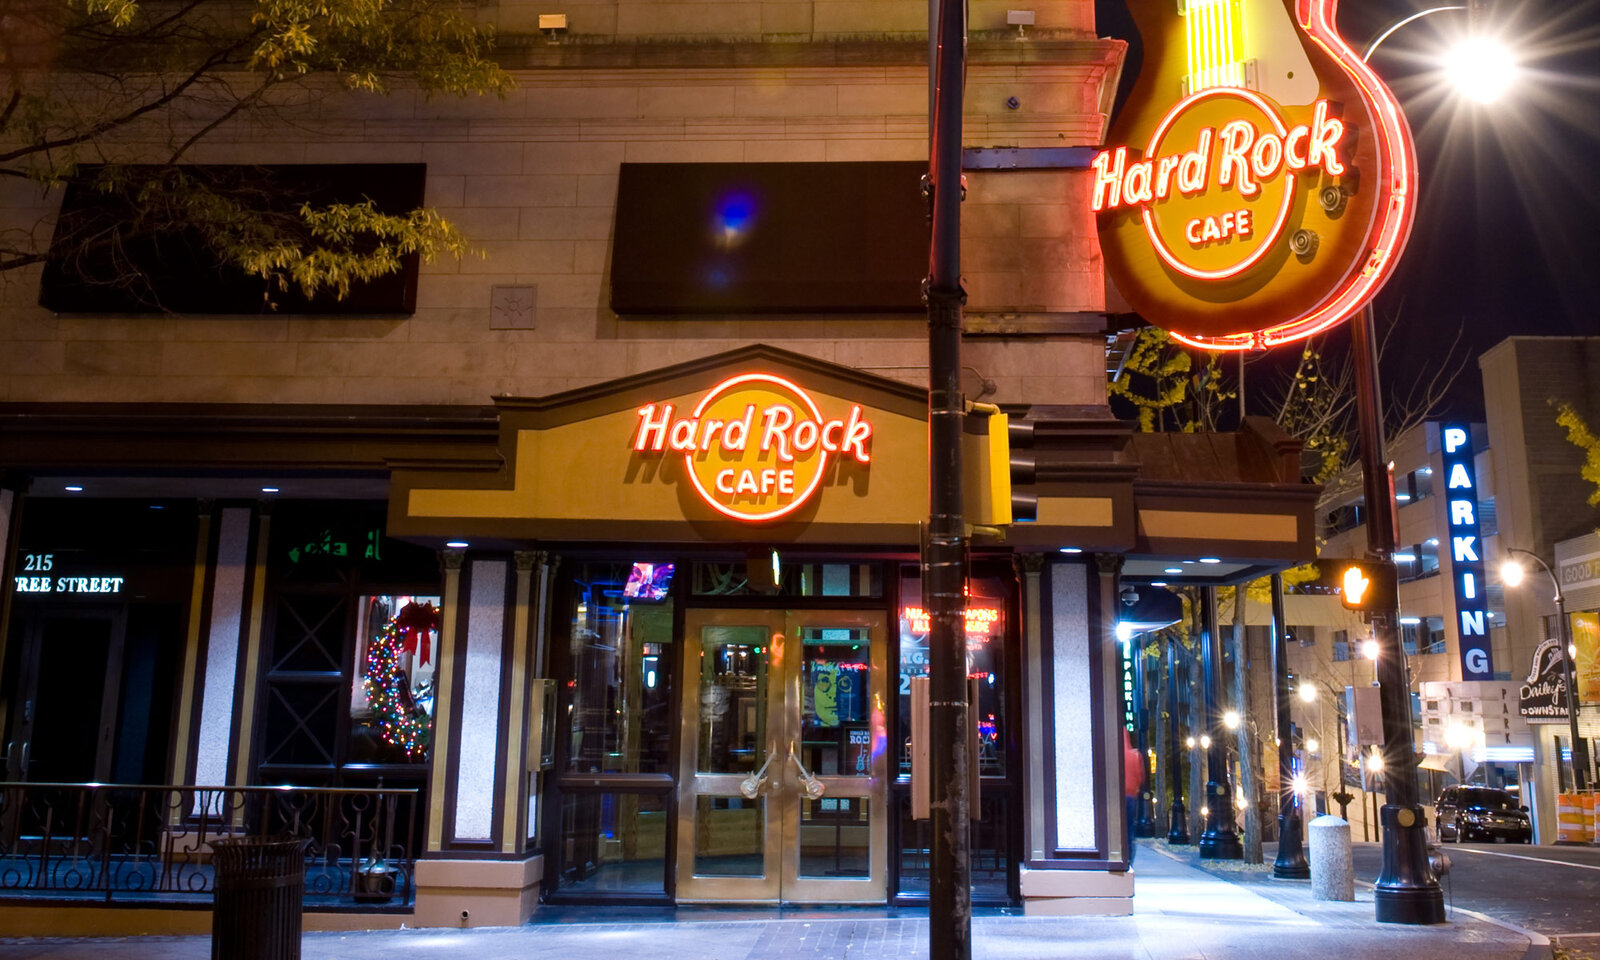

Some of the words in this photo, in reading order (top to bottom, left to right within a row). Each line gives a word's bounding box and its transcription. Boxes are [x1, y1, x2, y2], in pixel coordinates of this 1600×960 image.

[1091, 128, 1213, 212] Hard
[1218, 98, 1345, 196] Rock
[1184, 209, 1251, 245] CAFE
[633, 401, 756, 452] Hard
[760, 402, 874, 463] Rock
[715, 468, 795, 495] CAFE
[23, 553, 55, 572] 215
[1443, 427, 1490, 675] PARKING
[56, 577, 124, 593] STREET
[1564, 563, 1593, 583] GOOD
[1123, 660, 1134, 732] PARKING
[1519, 679, 1568, 706] Dailey's
[1501, 687, 1511, 745] PARK
